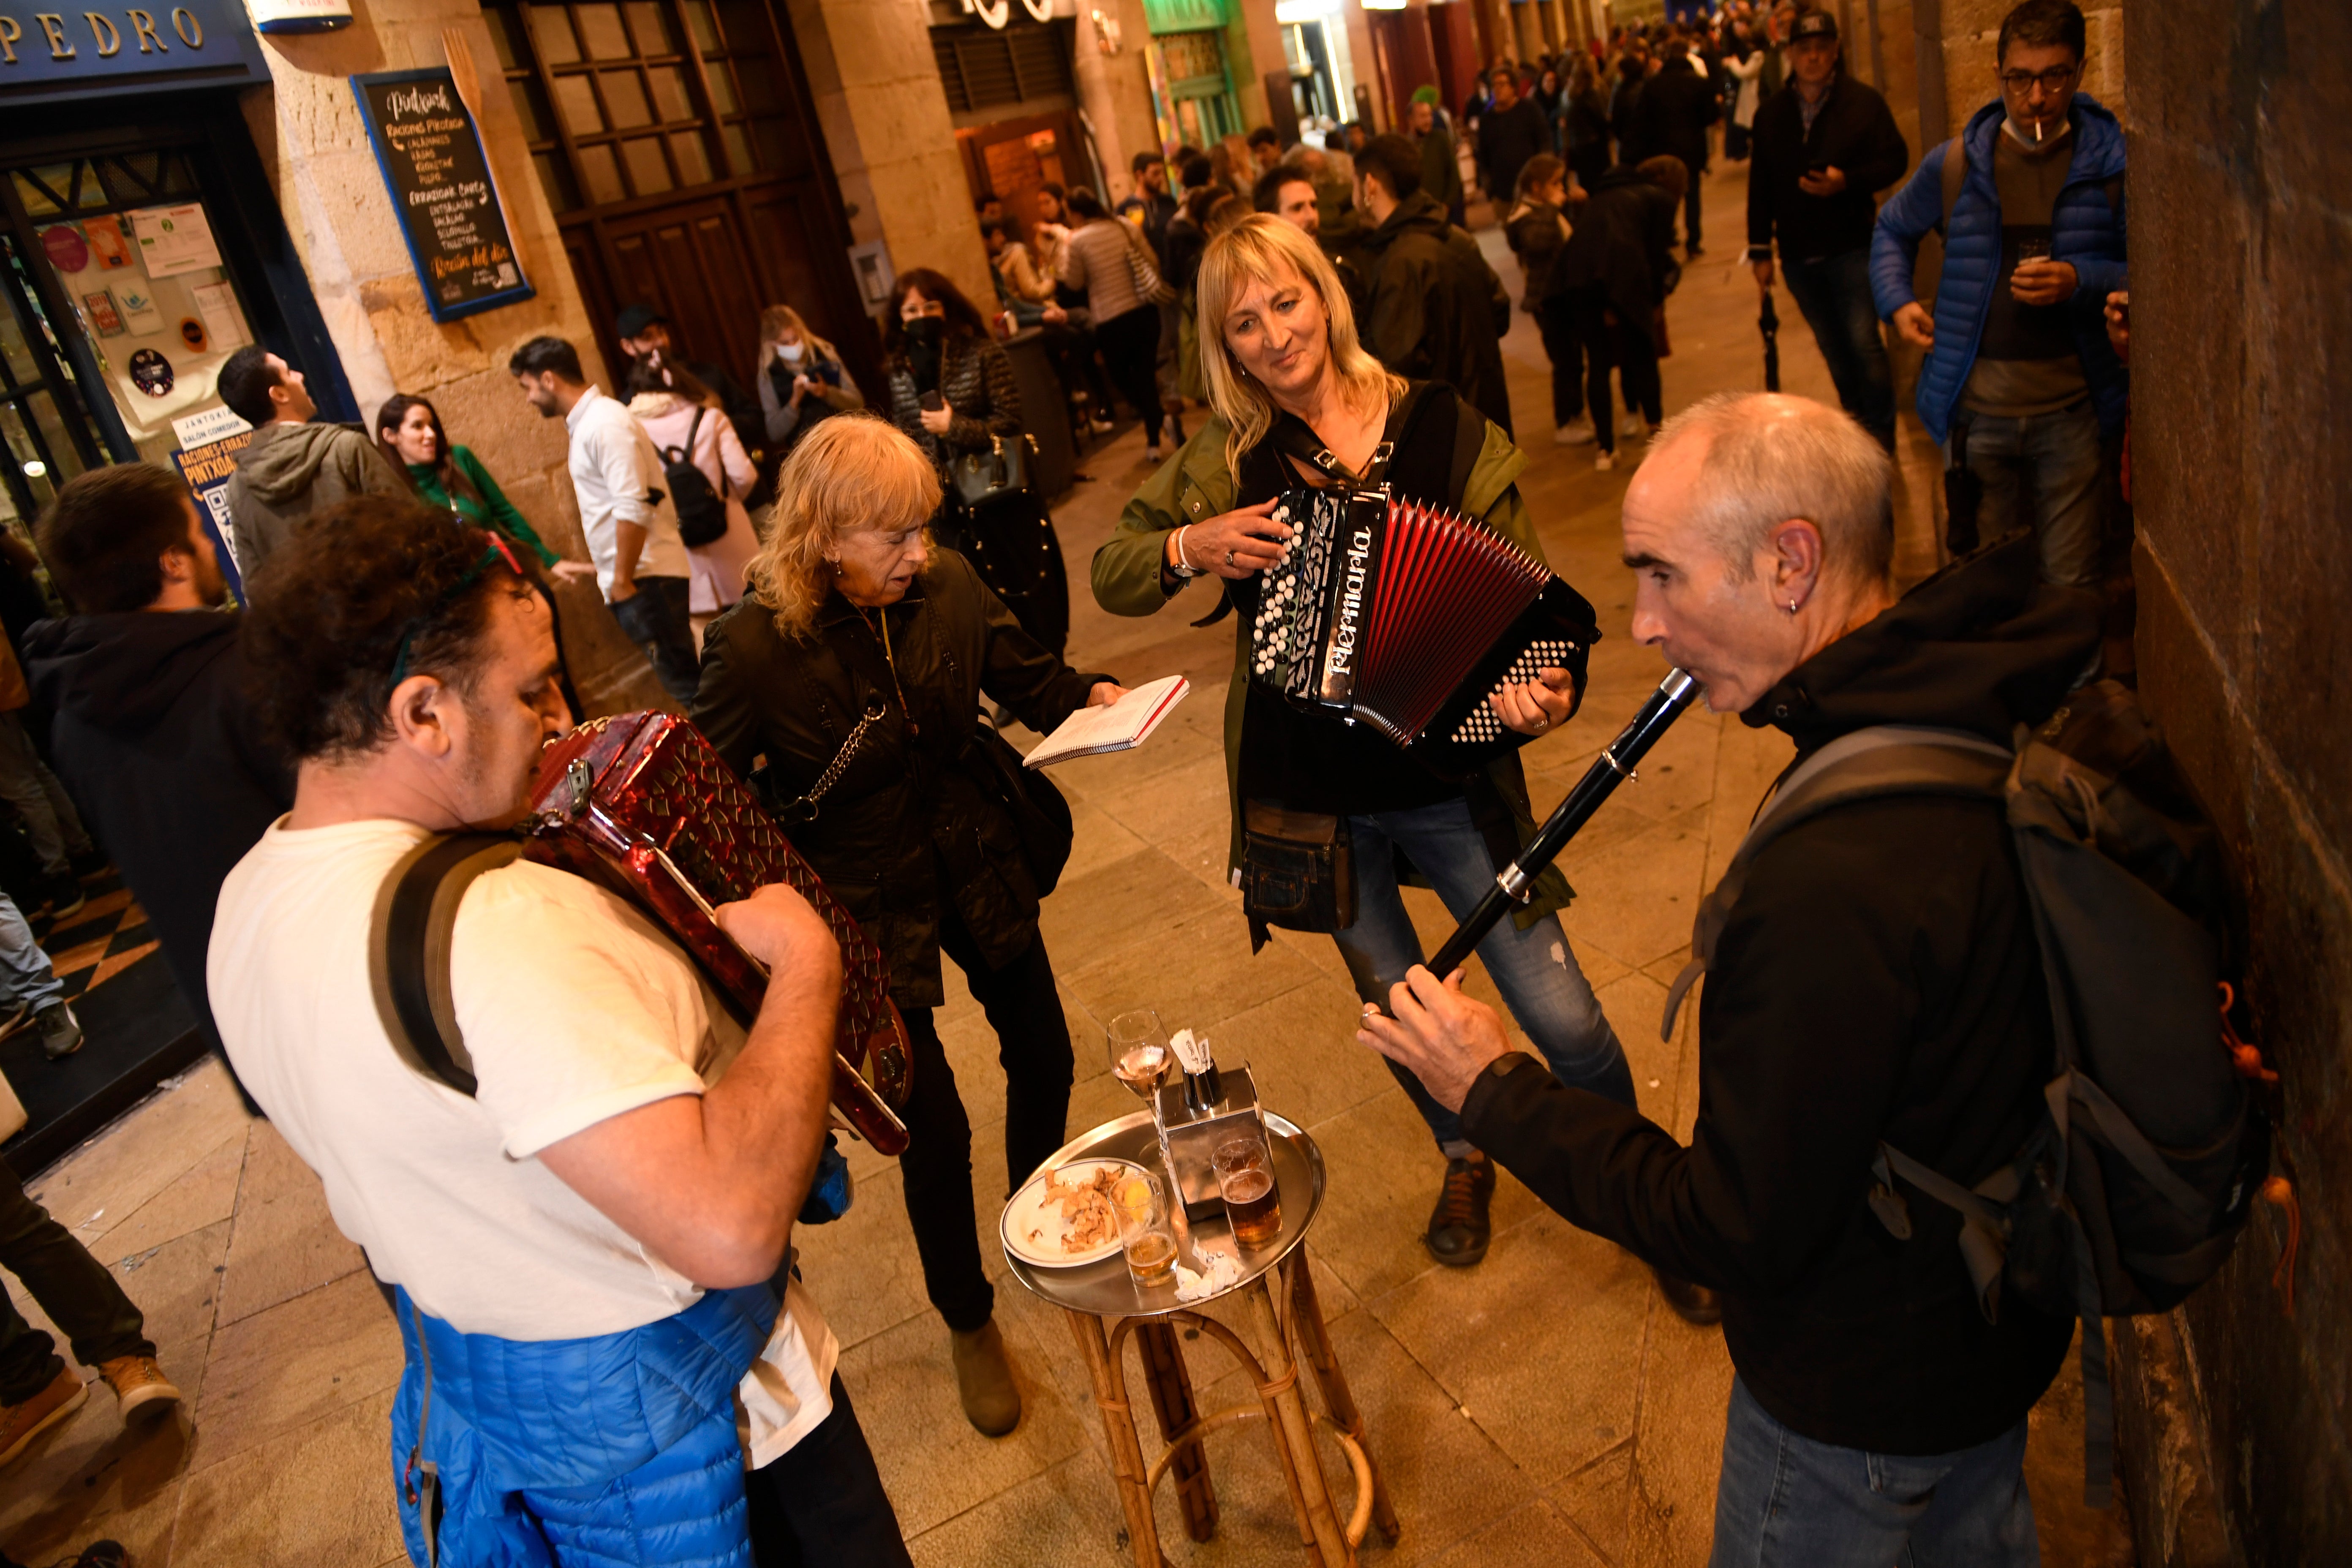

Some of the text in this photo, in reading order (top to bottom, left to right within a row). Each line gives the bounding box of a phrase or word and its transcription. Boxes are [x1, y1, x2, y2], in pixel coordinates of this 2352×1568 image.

[0, 7, 204, 63] PEDRO
[207, 420, 240, 436] COMEDOR
[1327, 525, 1372, 676] Piermaria
